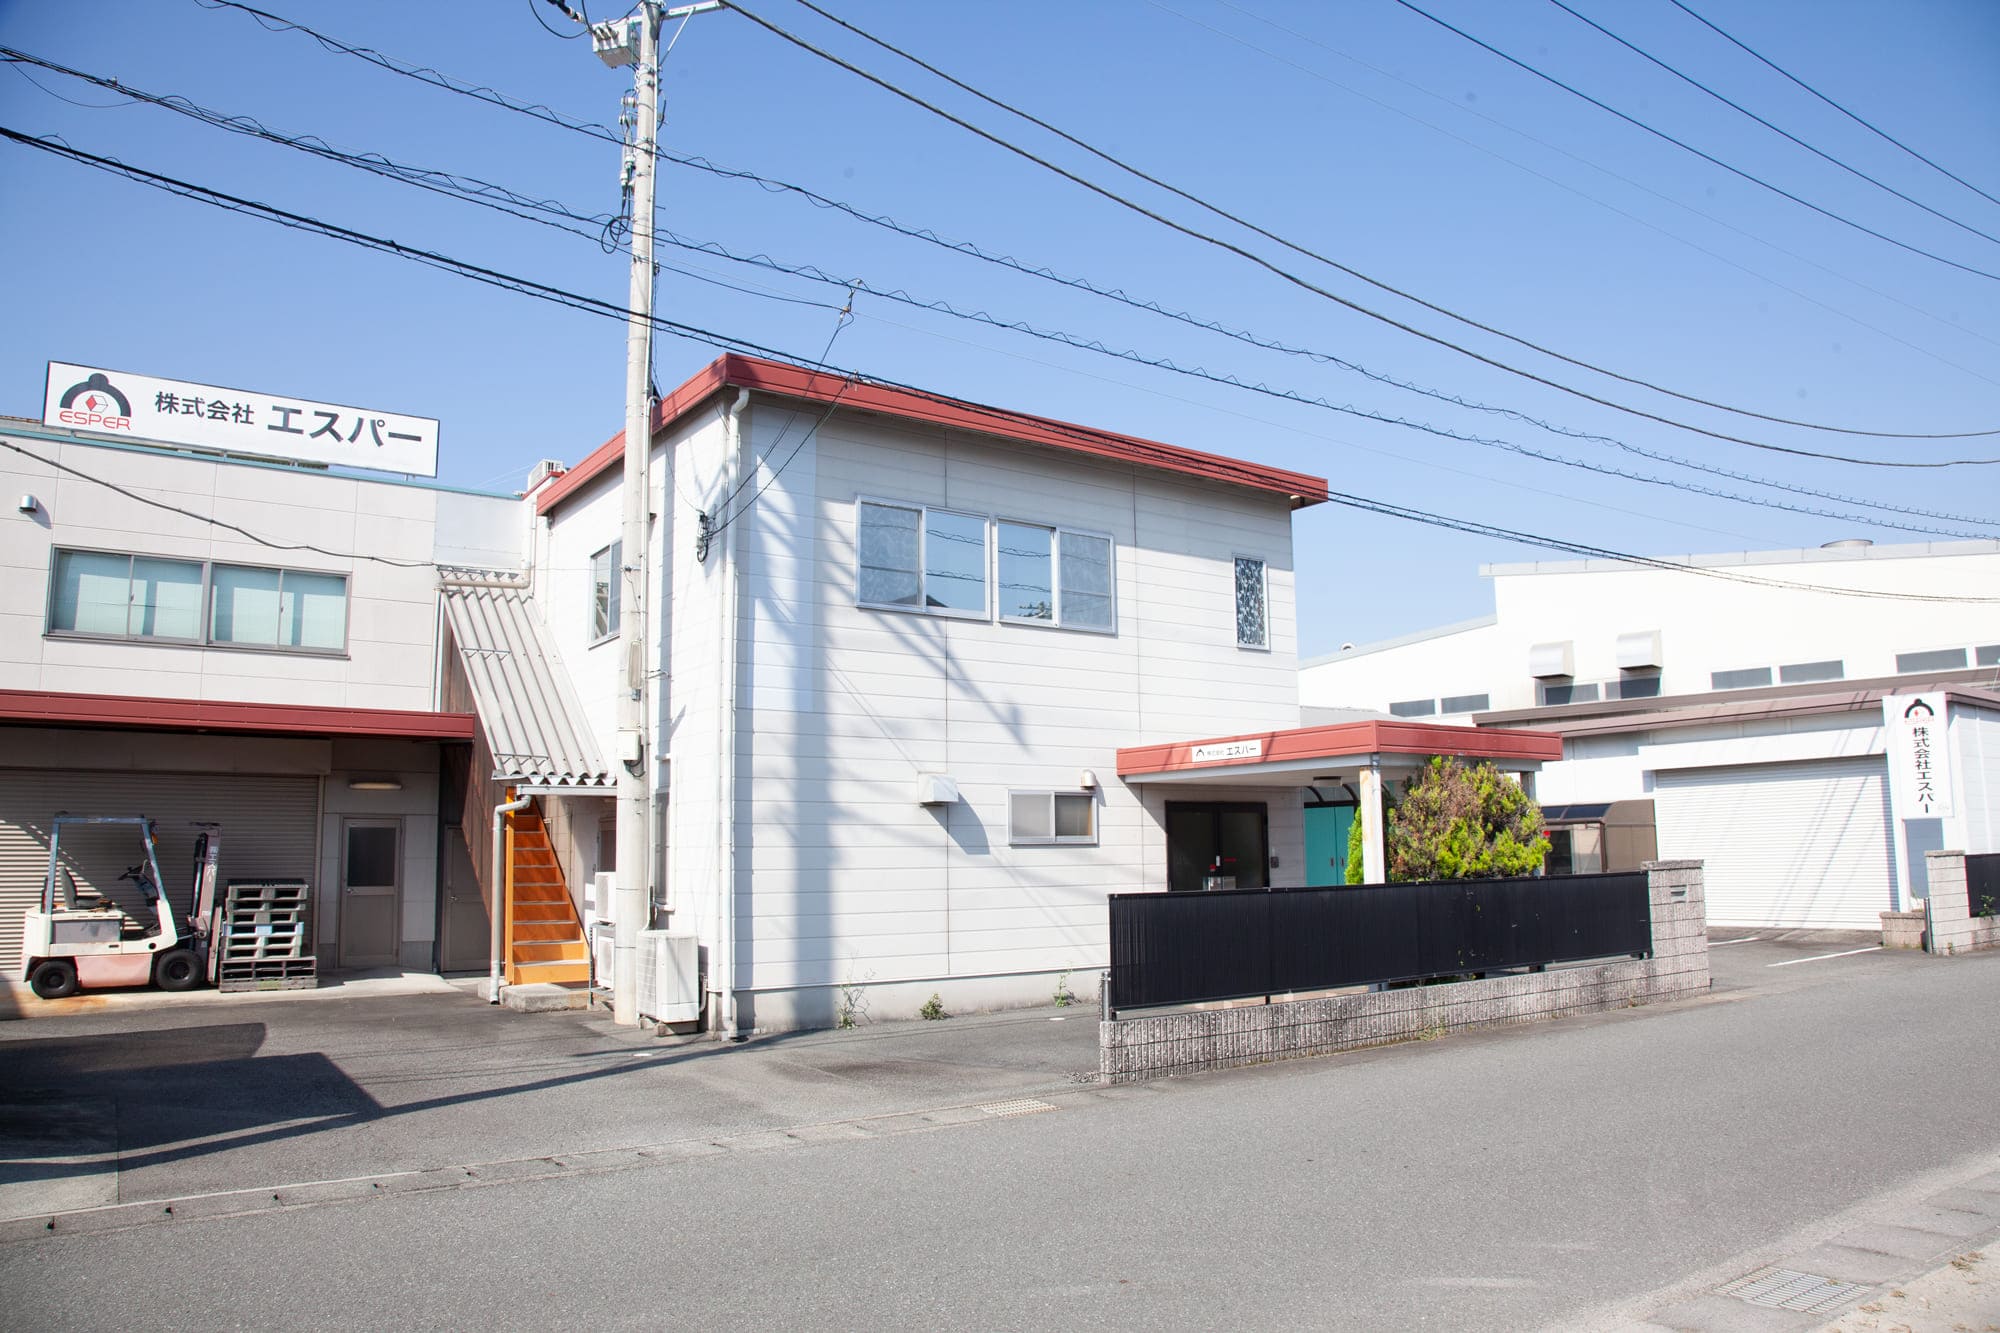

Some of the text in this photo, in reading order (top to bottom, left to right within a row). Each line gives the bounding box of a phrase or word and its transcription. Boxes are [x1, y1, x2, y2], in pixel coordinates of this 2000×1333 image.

[59, 411, 131, 430] ESPER
[155, 391, 422, 447] 株式会社 エスパー
